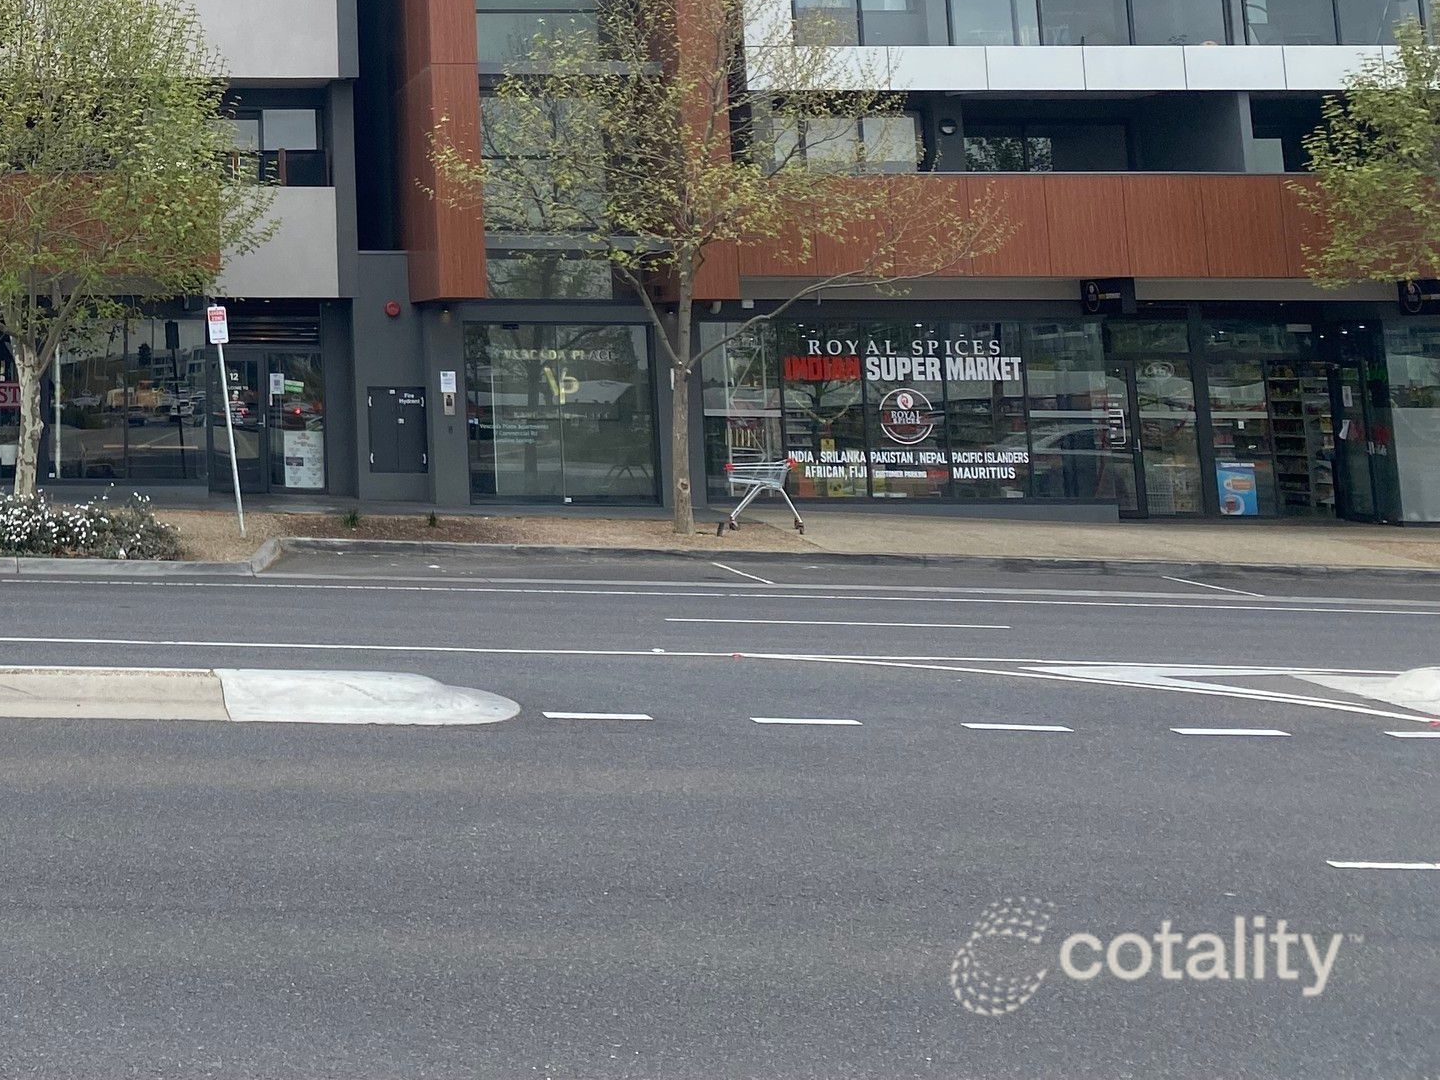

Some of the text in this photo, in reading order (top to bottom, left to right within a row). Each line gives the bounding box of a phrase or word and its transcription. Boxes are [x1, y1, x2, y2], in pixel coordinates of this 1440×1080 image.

[807, 339, 1002, 356] ROYAL SPICES
[785, 356, 1022, 381] INDIAN SUPER MARKET
[229, 372, 239, 381] 12
[891, 410, 922, 419] ROYAL
[788, 450, 1029, 464] INDIA SRILANKA PAKISTAN NEPAL PACIFIC ISLANDERS
[805, 465, 868, 480] AFRICAN, FIJI
[953, 467, 1016, 479] MAURITIUS
